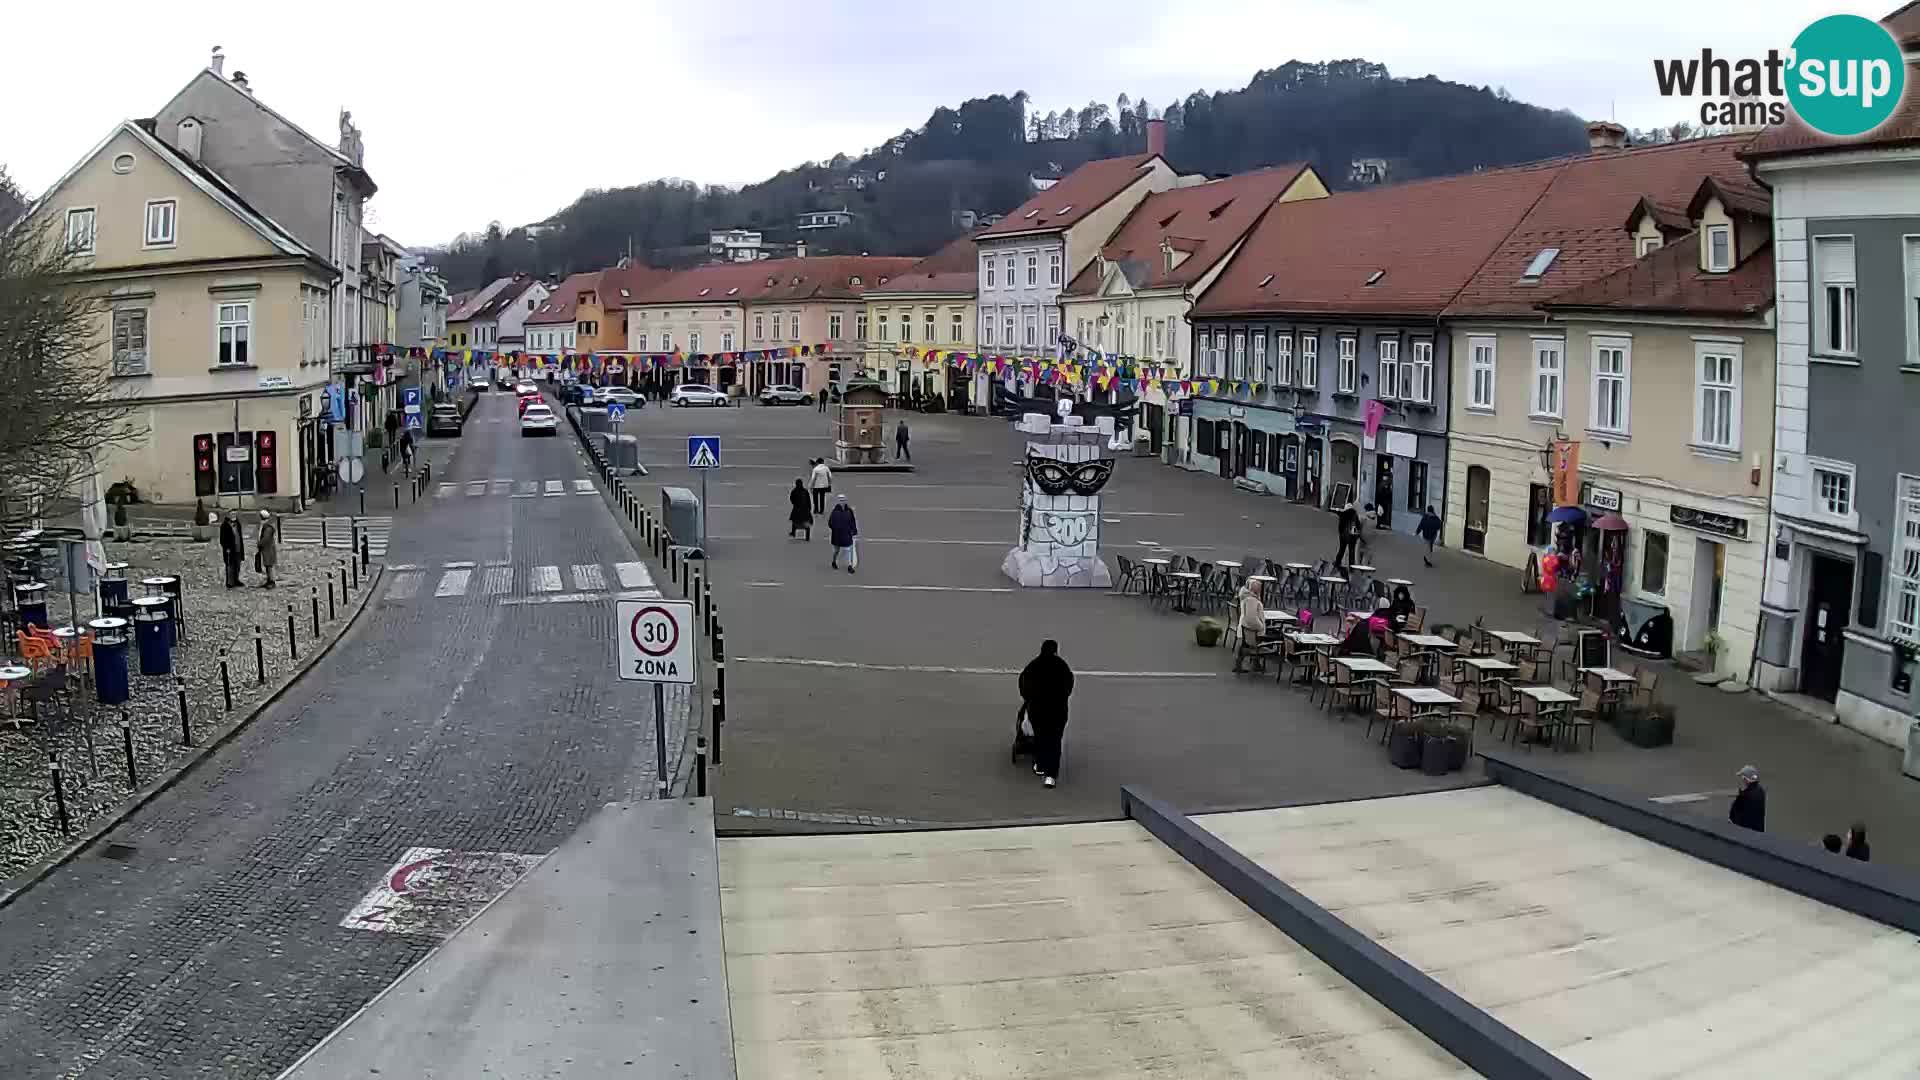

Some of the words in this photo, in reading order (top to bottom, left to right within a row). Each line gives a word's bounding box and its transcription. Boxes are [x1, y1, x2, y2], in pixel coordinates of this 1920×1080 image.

[408, 391, 416, 403] P
[644, 622, 667, 643] 30
[634, 659, 678, 677] ZONA
